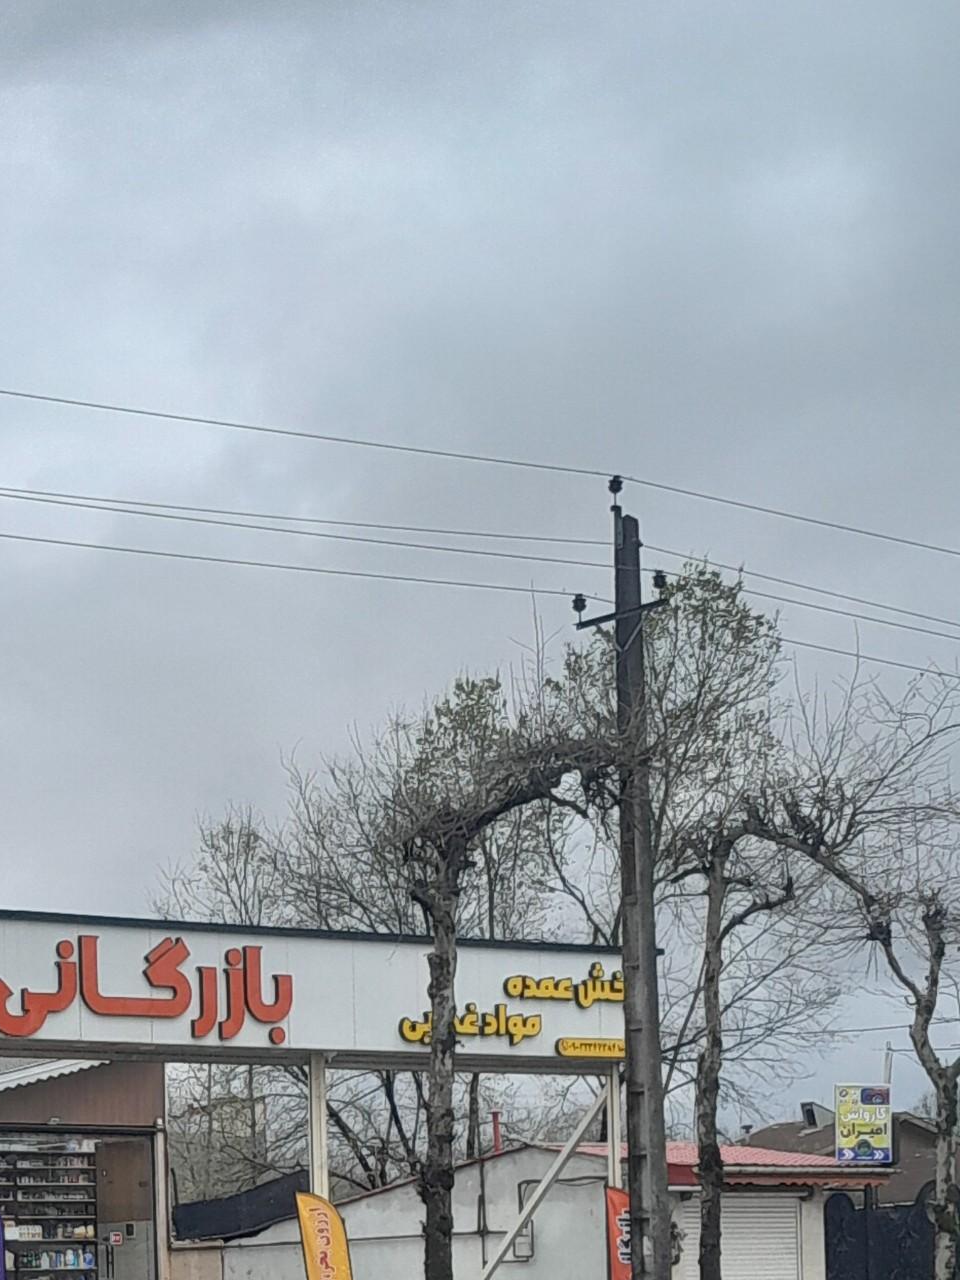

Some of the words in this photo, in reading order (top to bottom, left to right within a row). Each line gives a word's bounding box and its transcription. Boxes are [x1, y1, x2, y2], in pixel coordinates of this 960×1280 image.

[503, 974, 574, 1001] عمده
[573, 961, 625, 1009] خش
[479, 1003, 542, 1048] مواد
[840, 1122, 888, 1140] امیران
